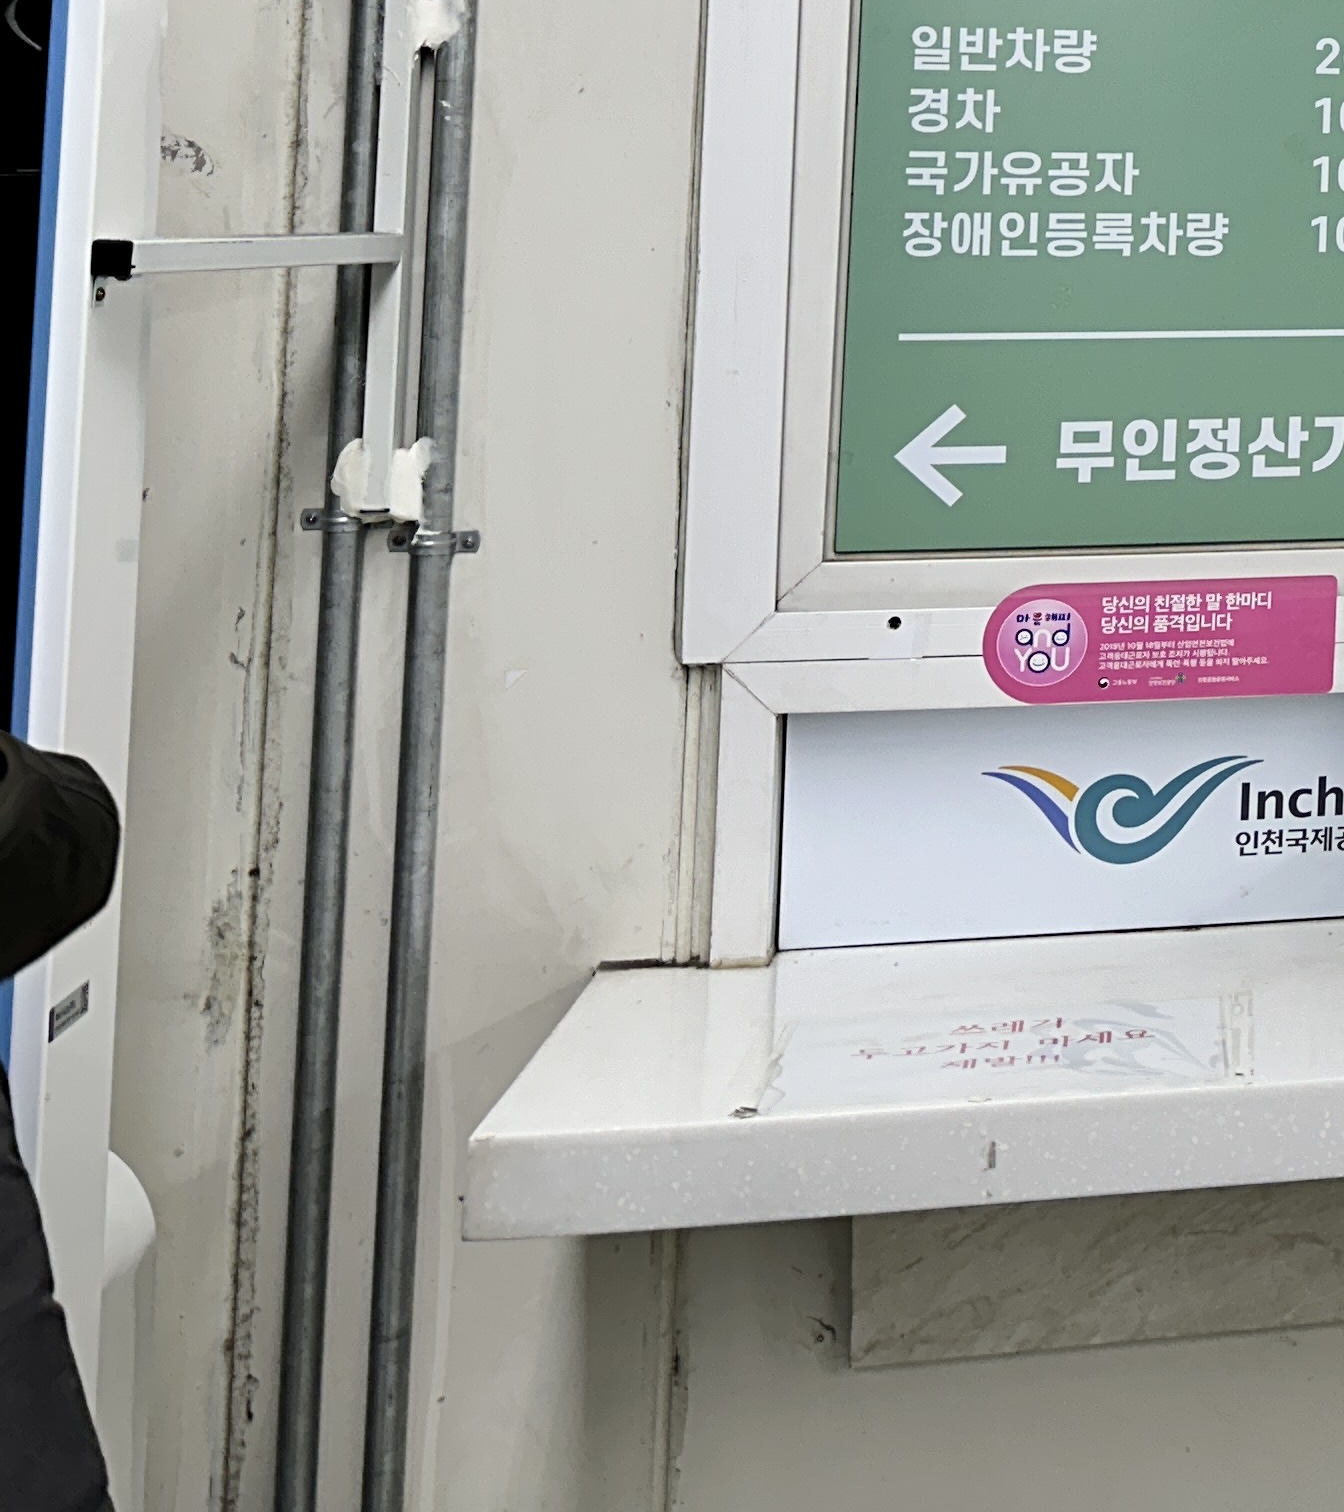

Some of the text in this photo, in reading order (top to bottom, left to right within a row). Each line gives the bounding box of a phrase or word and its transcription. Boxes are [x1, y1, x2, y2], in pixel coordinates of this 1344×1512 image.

[911, 25, 1098, 73] 일반차량
[906, 88, 1001, 134] 경차
[904, 149, 1140, 197] 국가유공자
[901, 210, 1230, 259] 장애인등록차량
[1101, 591, 1272, 614] 당신의 친절한 말 한마디
[1101, 612, 1233, 635] 당신의 품격입니다
[949, 1016, 1065, 1037] 쓰레기
[1038, 1029, 1156, 1048] 마세요
